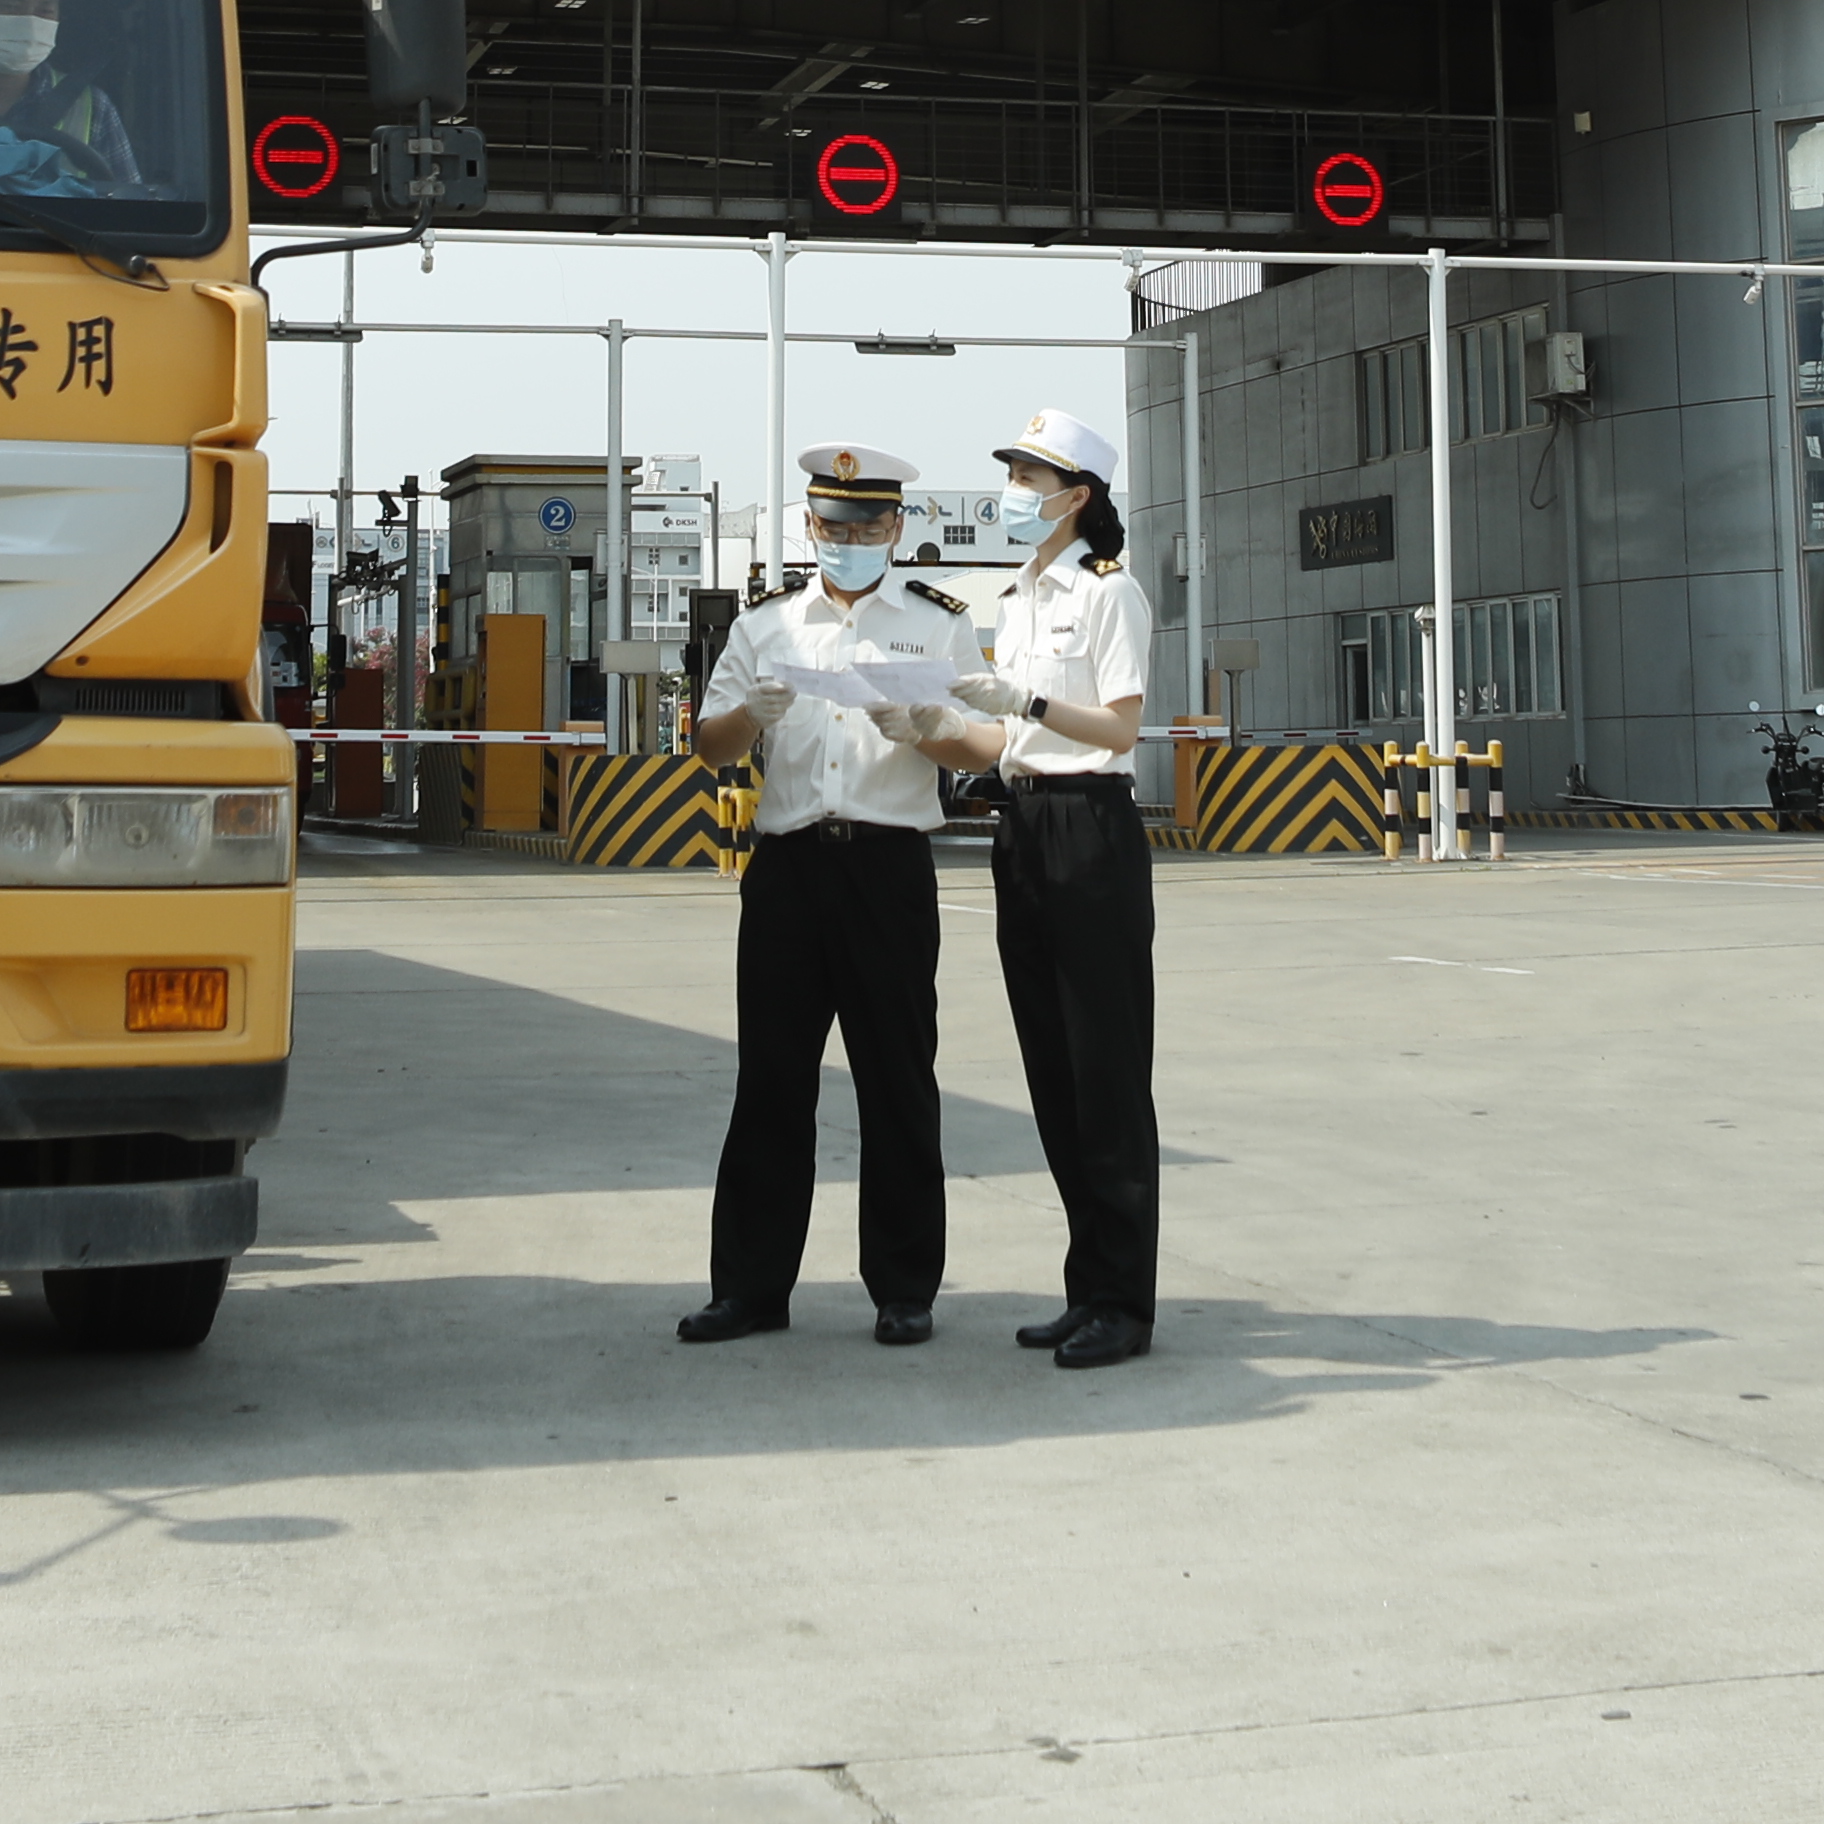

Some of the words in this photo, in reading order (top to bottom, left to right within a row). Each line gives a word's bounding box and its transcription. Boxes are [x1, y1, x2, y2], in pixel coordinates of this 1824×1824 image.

[549, 504, 566, 526] 2
[980, 501, 995, 522] 4
[390, 536, 401, 550] 6
